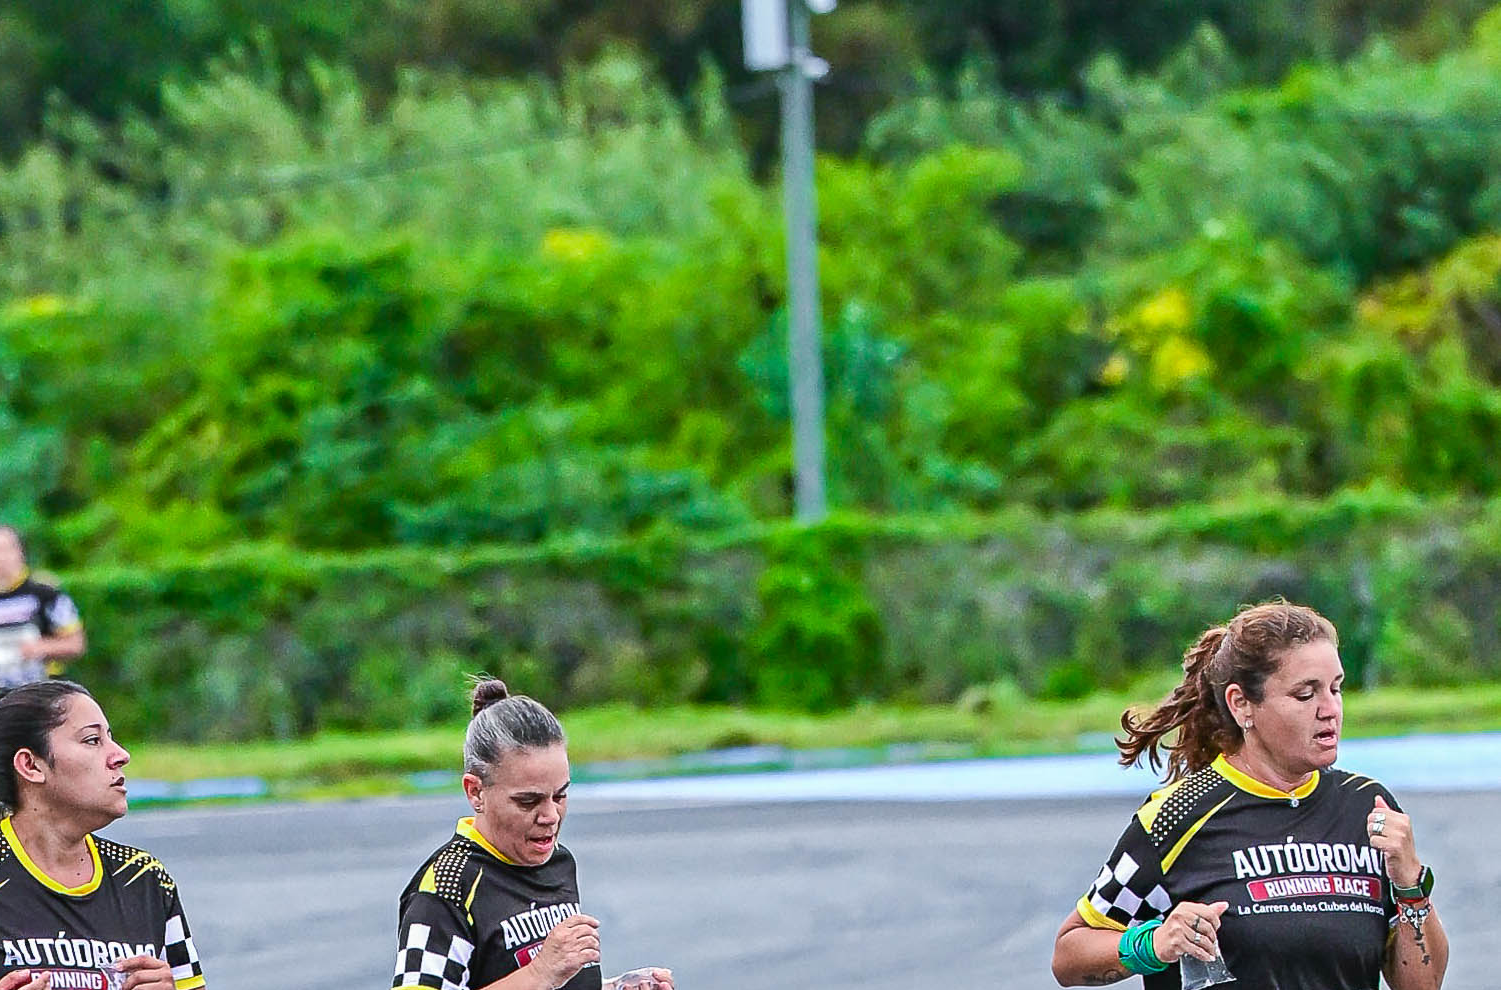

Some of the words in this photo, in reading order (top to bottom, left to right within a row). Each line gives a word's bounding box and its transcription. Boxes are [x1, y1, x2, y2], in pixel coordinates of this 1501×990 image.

[1263, 877, 1330, 898] RUNNING
[1333, 877, 1370, 897] RACE
[1238, 905, 1250, 915] La
[1252, 903, 1289, 914] Carrera
[1290, 903, 1302, 912] de
[1303, 902, 1317, 912] los
[1318, 901, 1349, 912] Clubes
[1350, 901, 1363, 911] del
